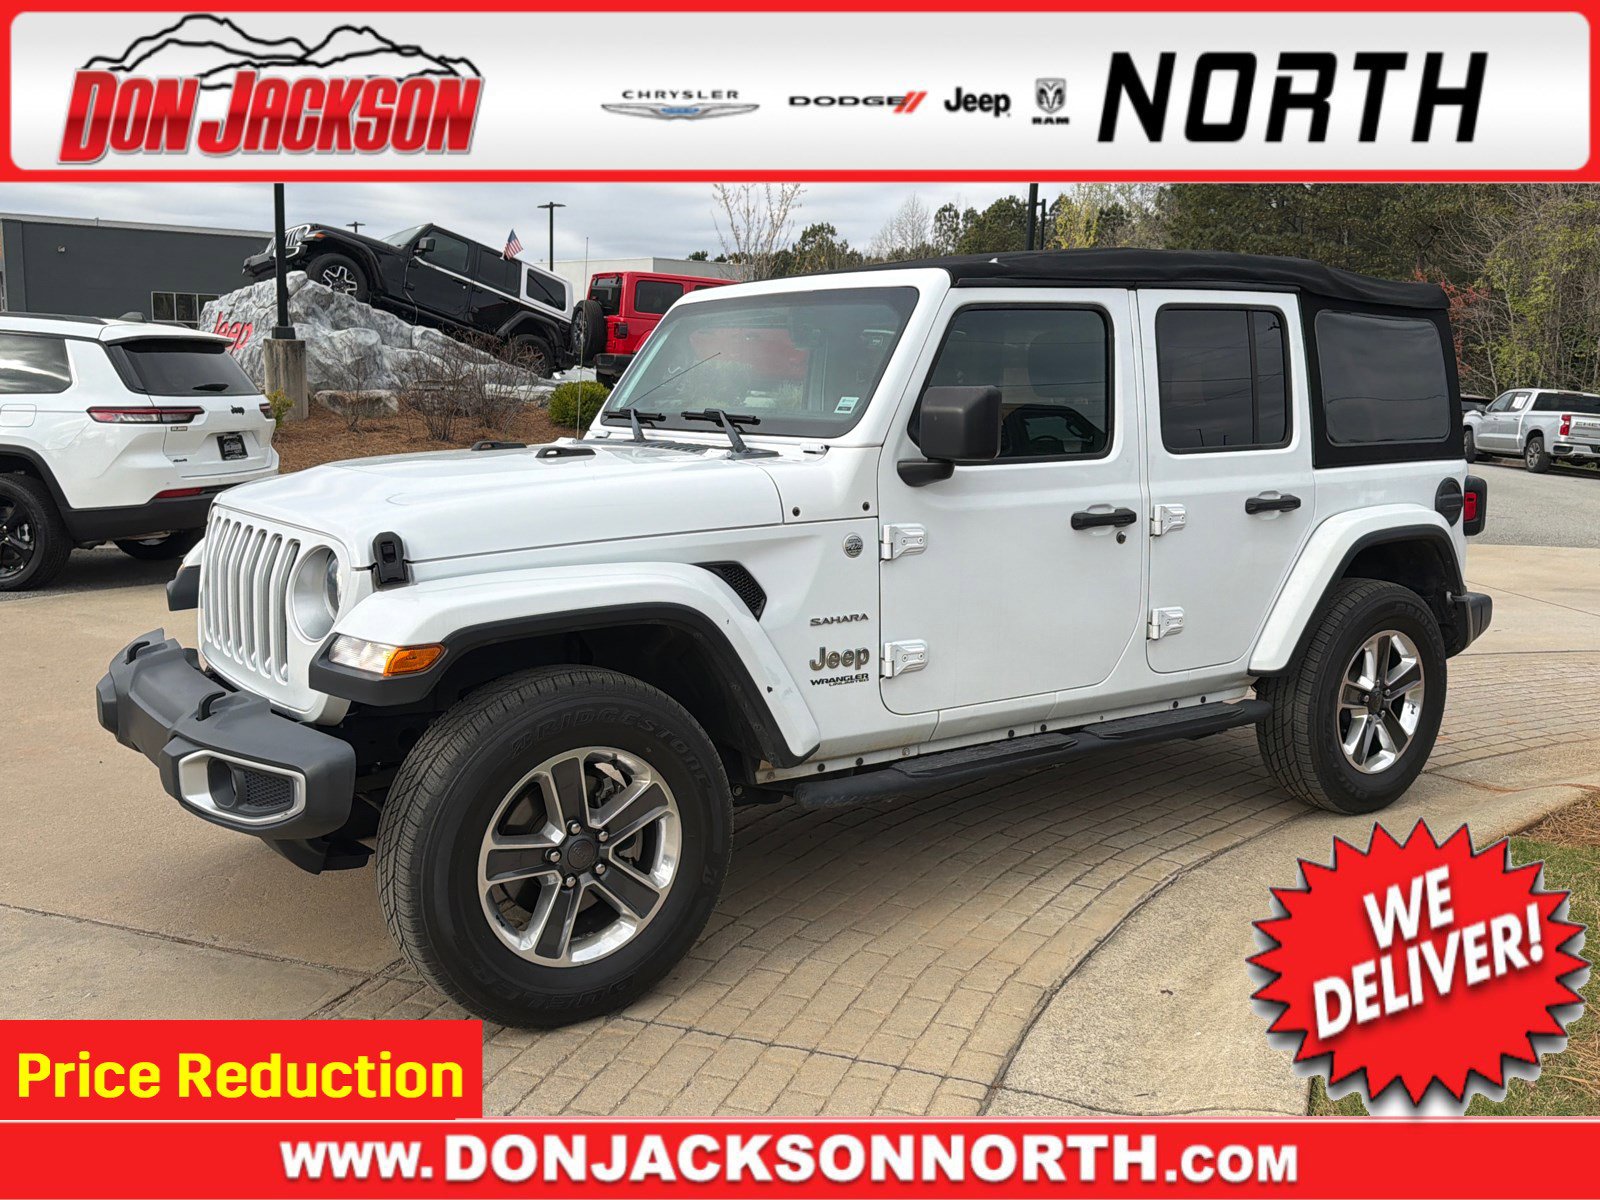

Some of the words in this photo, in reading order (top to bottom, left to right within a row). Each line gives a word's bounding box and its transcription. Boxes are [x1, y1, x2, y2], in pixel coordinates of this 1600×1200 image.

[809, 613, 869, 626] SAHARA
[809, 646, 870, 671] Jeep
[810, 673, 869, 686] WRANGLER
[510, 706, 712, 789] BRIDGESTONE
